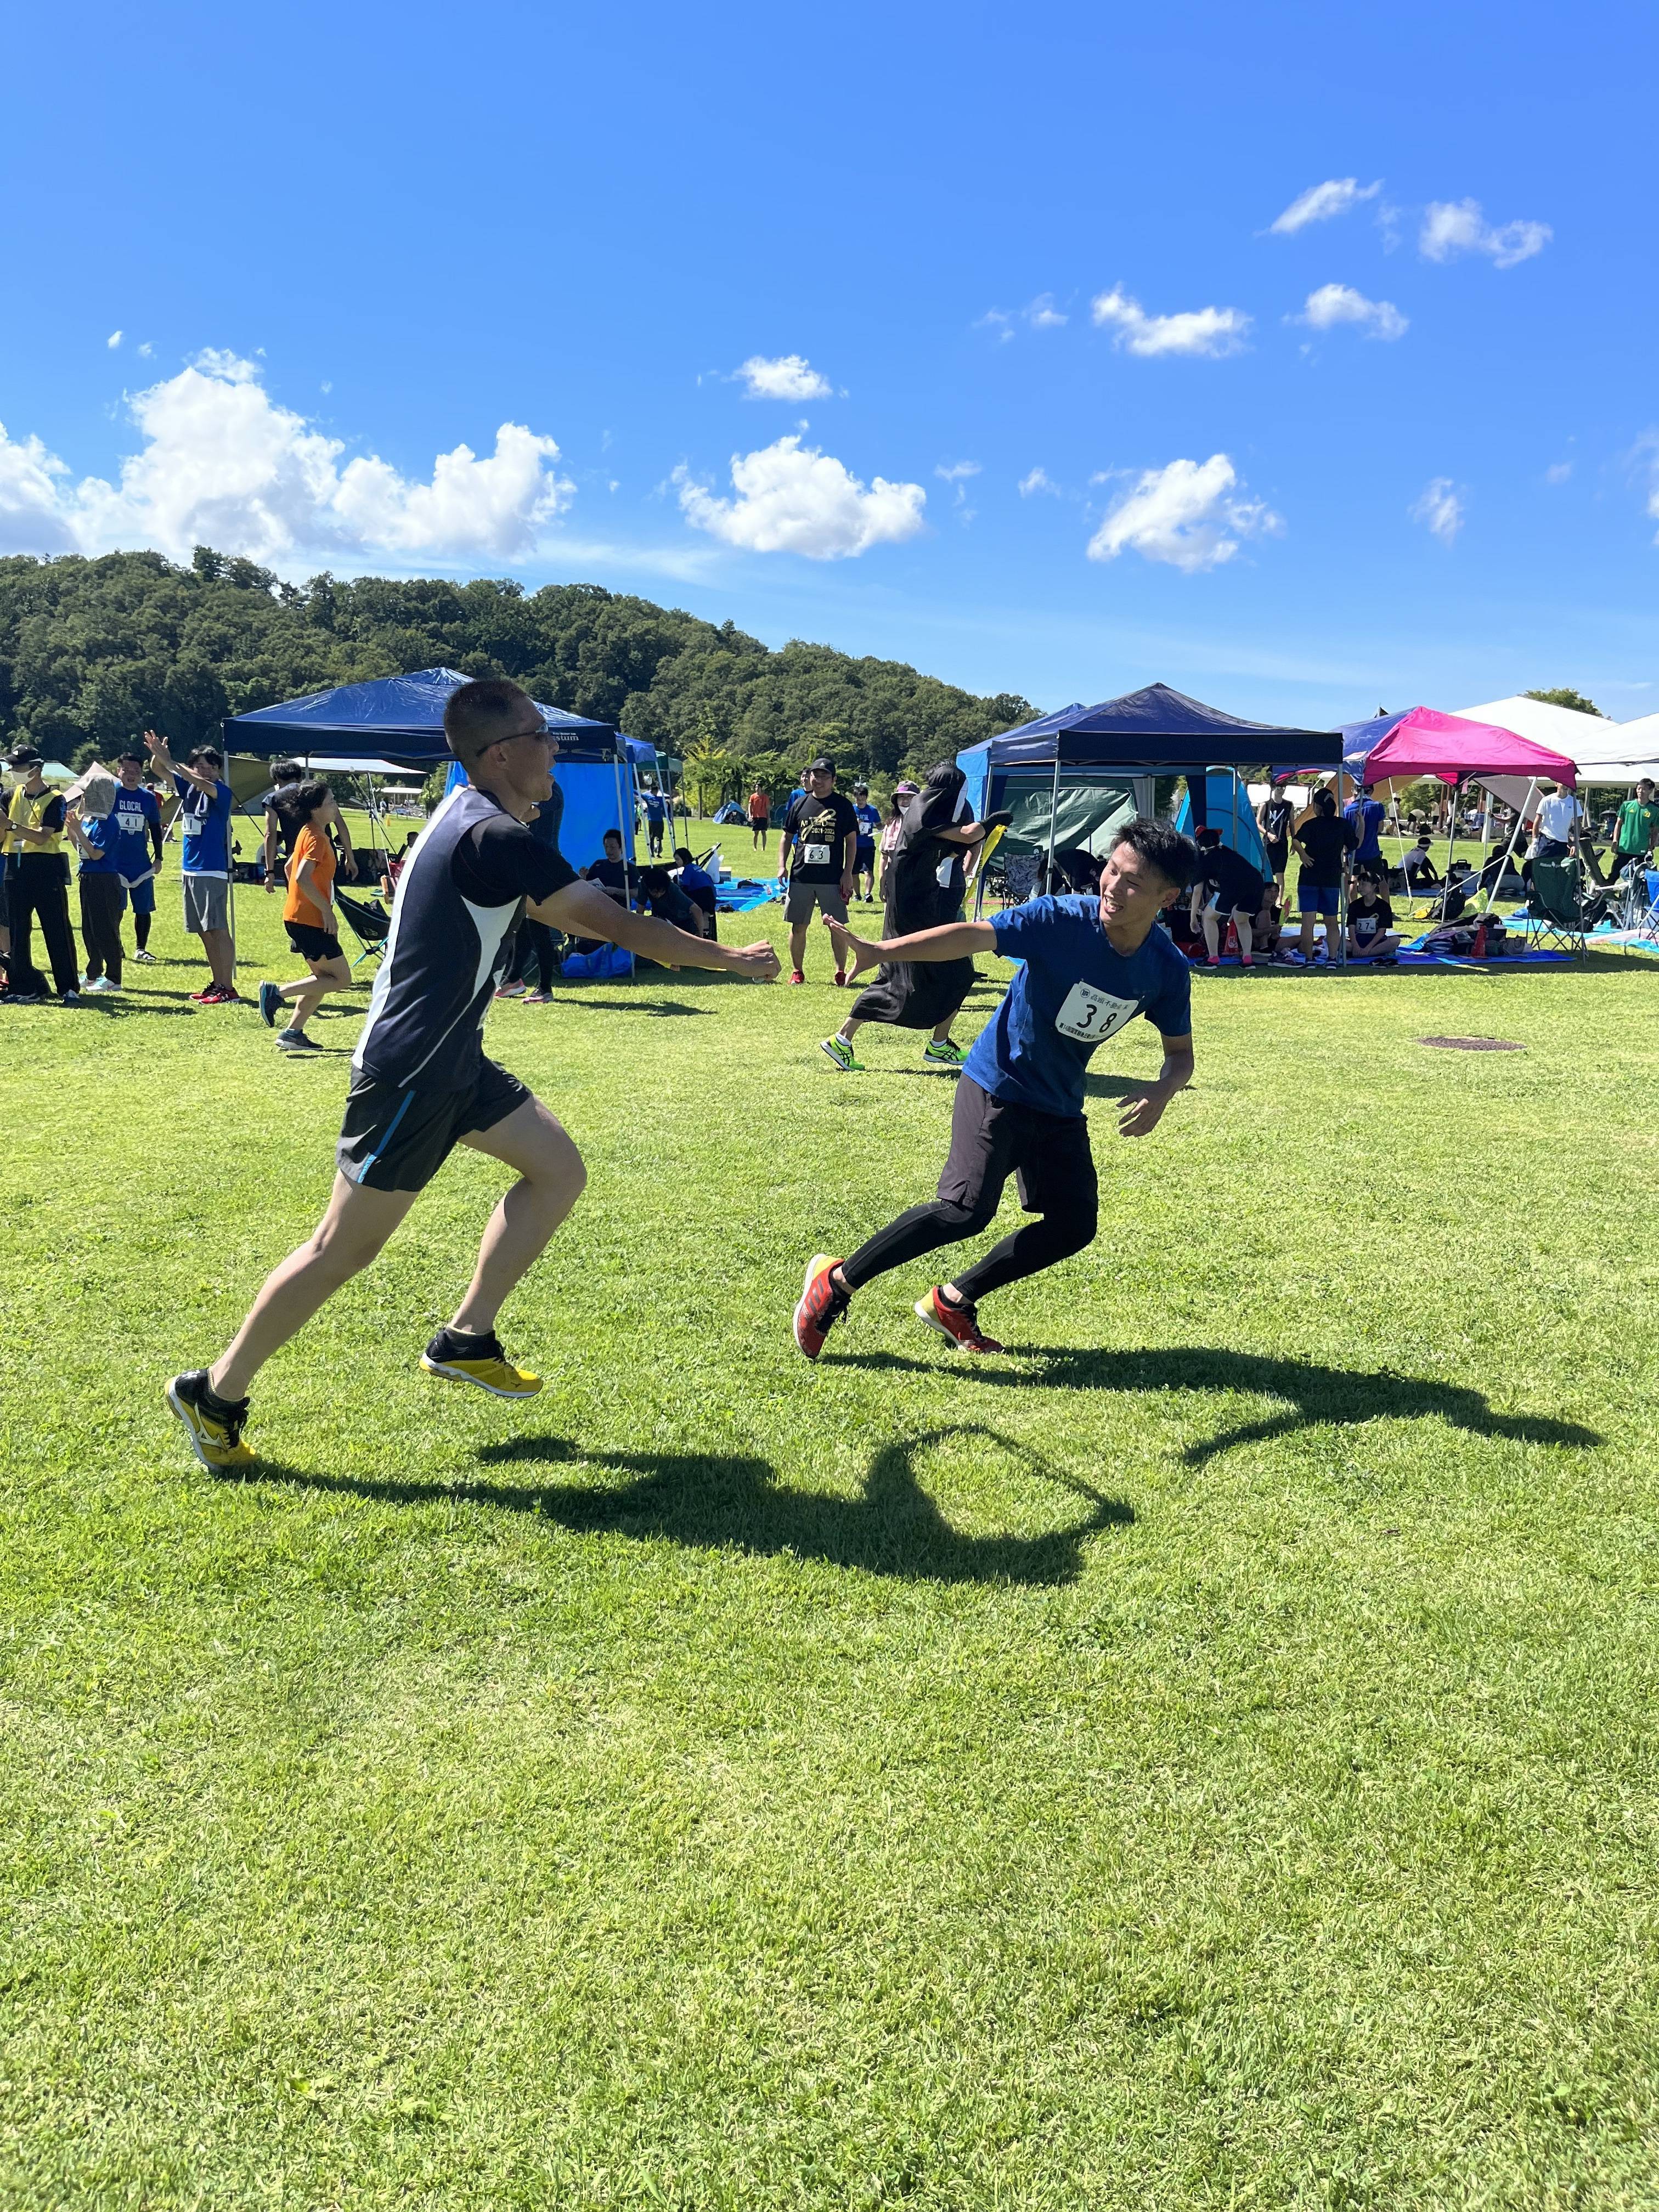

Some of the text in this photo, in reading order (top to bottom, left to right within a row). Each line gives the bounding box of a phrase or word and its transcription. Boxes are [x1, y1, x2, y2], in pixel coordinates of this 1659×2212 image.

[119, 800, 143, 812] GLOCAL
[125, 817, 137, 827] 41
[809, 850, 823, 859] 63
[1358, 922, 1370, 930] 27
[1076, 1004, 1118, 1033] 38
